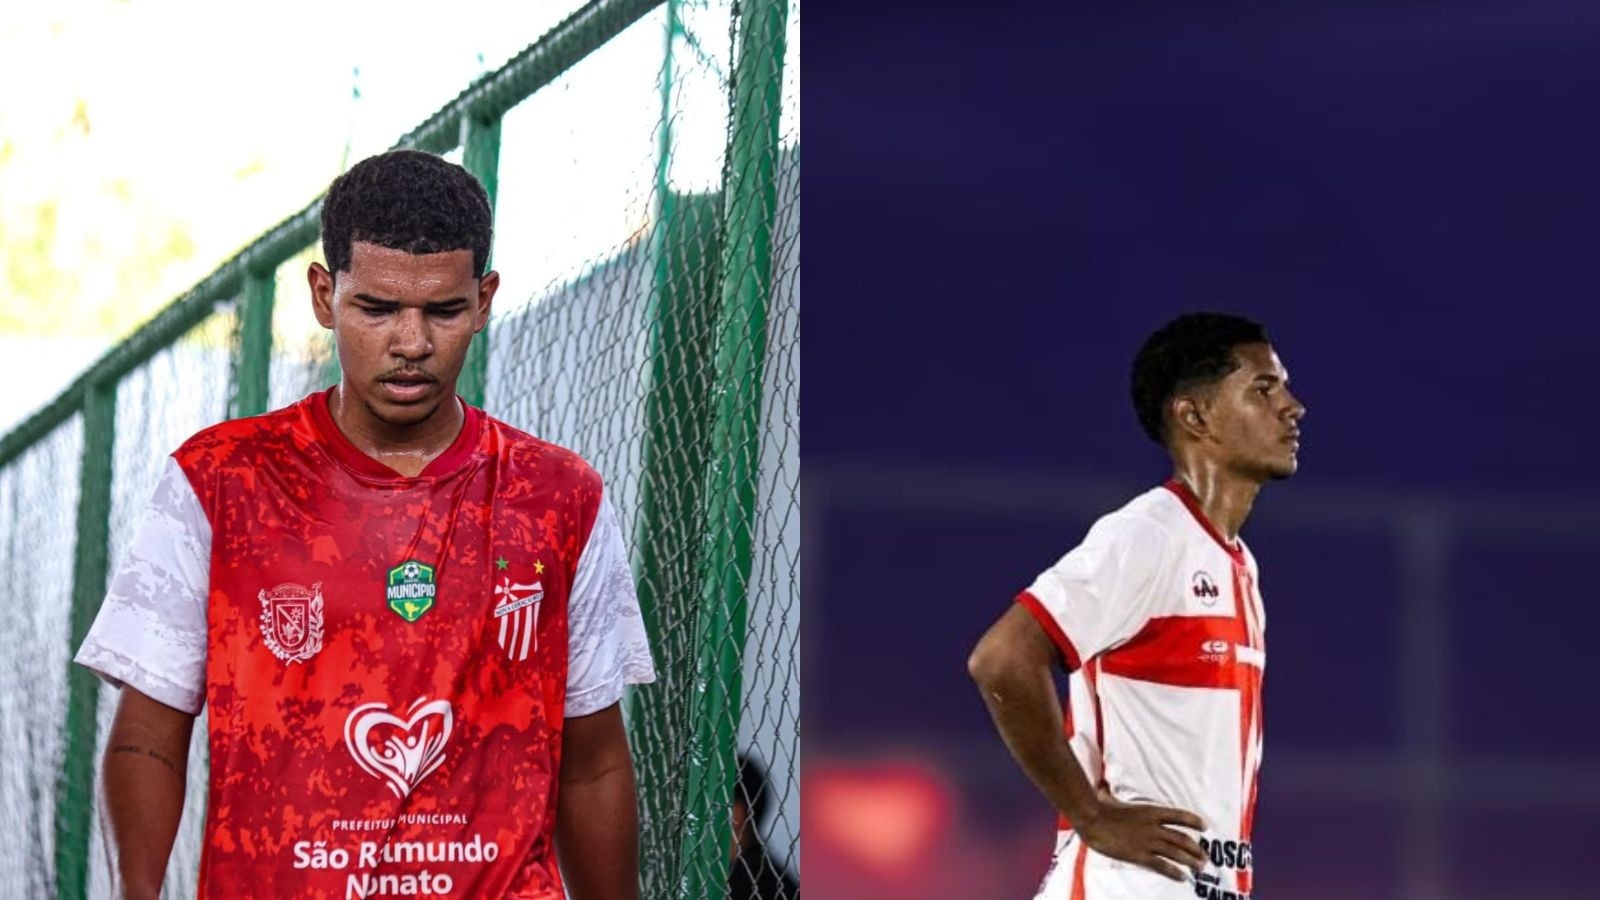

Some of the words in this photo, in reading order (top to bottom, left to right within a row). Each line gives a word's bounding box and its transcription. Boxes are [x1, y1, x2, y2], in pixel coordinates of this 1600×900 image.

[332, 819, 396, 831] PREFEITU
[397, 813, 469, 825] MUNICIPAL
[293, 840, 349, 869] São
[359, 833, 499, 869] Rimundo
